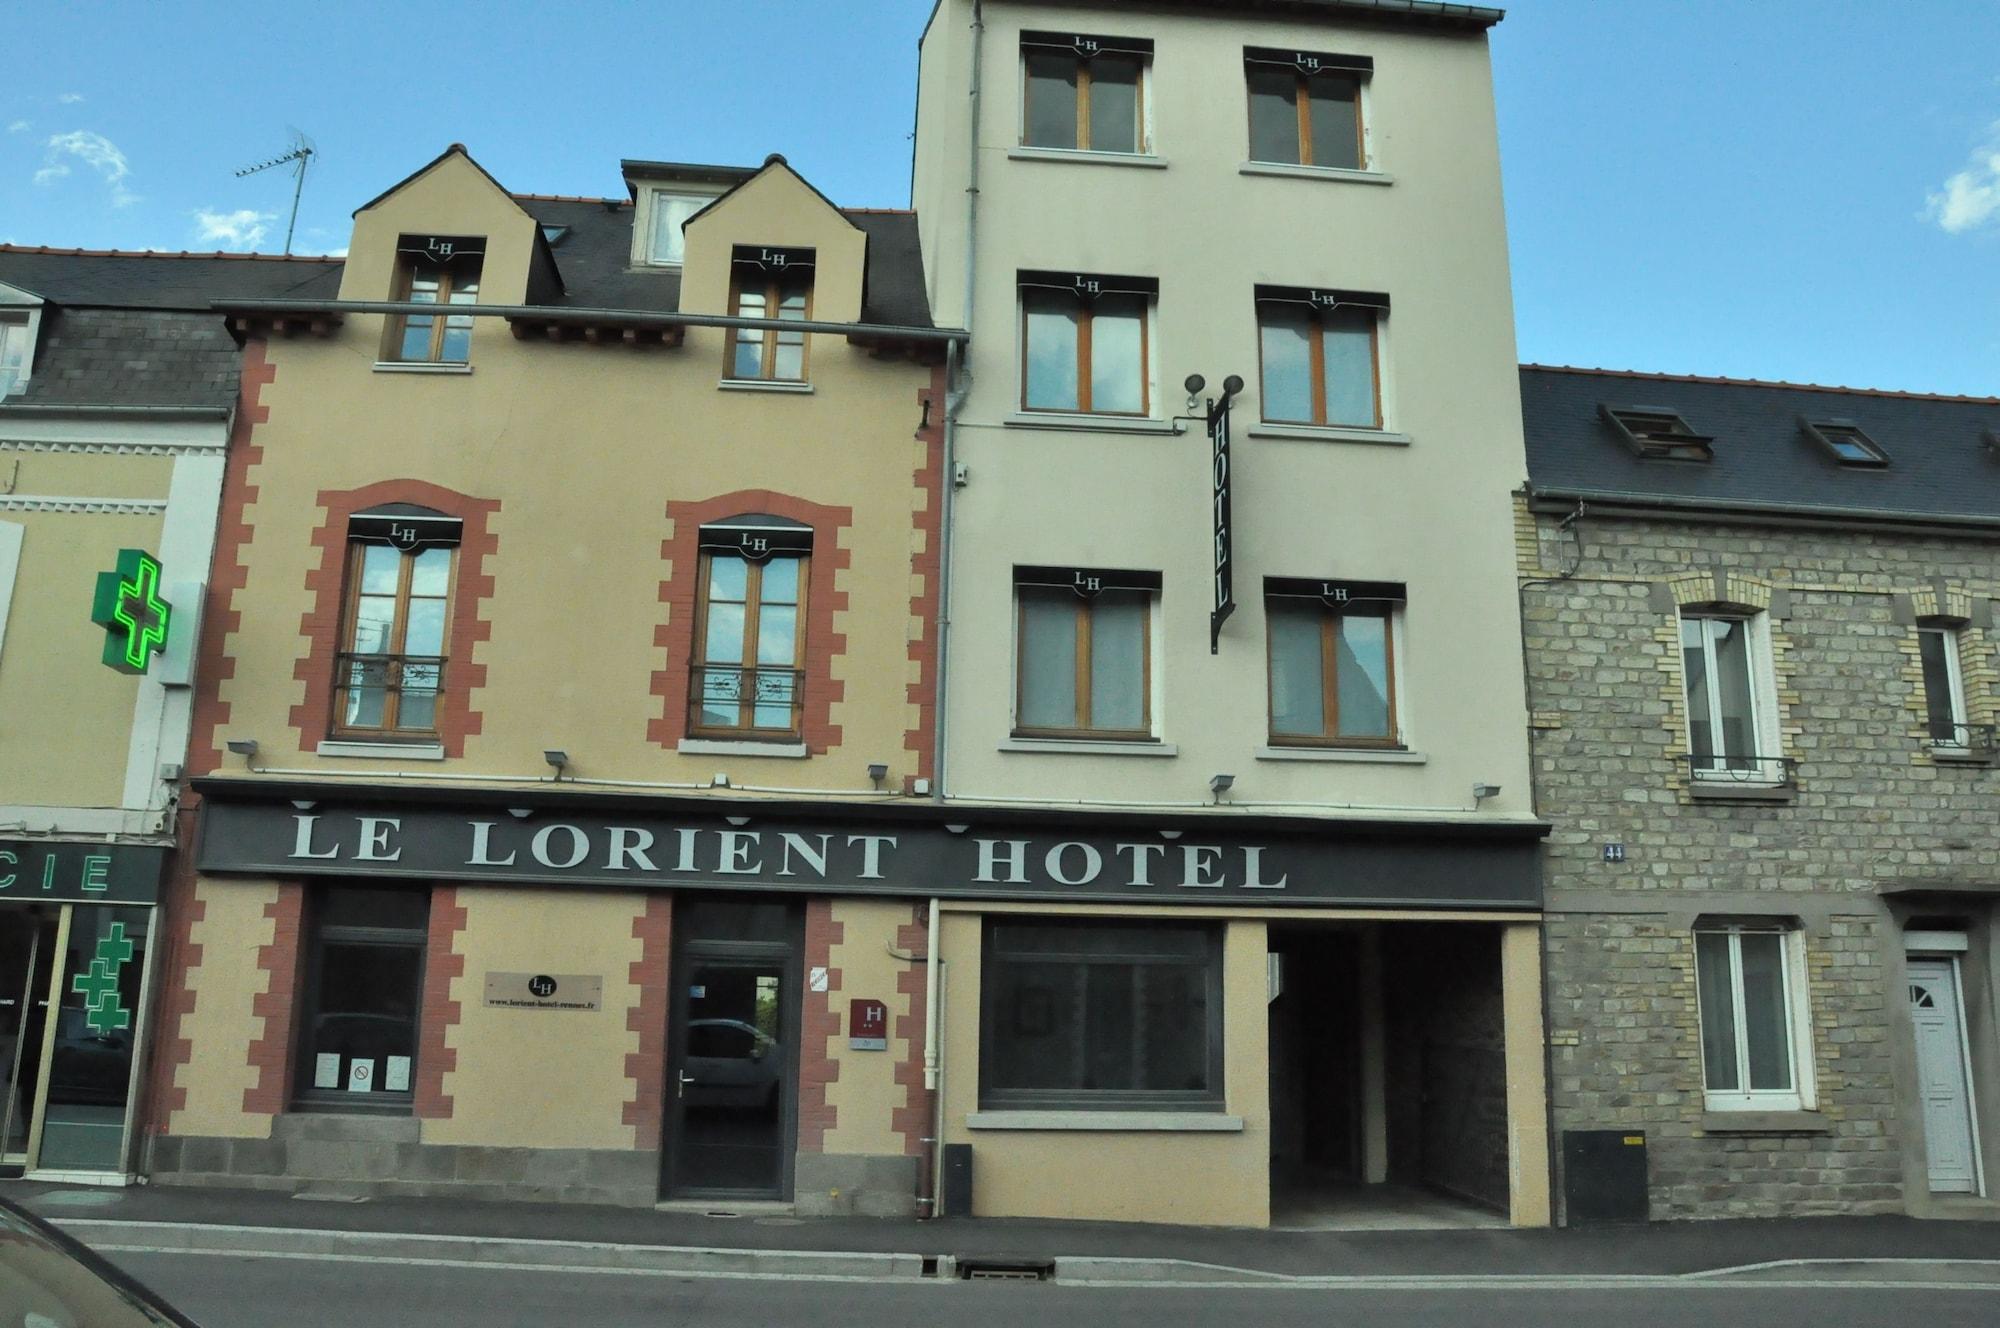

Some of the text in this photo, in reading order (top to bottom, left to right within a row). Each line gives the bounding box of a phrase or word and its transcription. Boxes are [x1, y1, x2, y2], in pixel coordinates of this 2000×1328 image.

[1074, 36, 1098, 50] LH
[1295, 52, 1318, 69] LH
[429, 238, 453, 254] LH
[761, 249, 786, 266] LH
[1075, 275, 1099, 292] LH
[1310, 290, 1335, 305] LH
[1213, 411, 1228, 608] HOTEL
[391, 523, 417, 542] LH
[741, 532, 767, 551] LH
[1074, 571, 1100, 590] LH
[1322, 583, 1349, 601] LH
[287, 814, 1288, 889] LE LORIENT HOTEL
[1606, 846, 1622, 859] 44
[532, 977, 553, 995] LH
[866, 1006, 882, 1021] H
